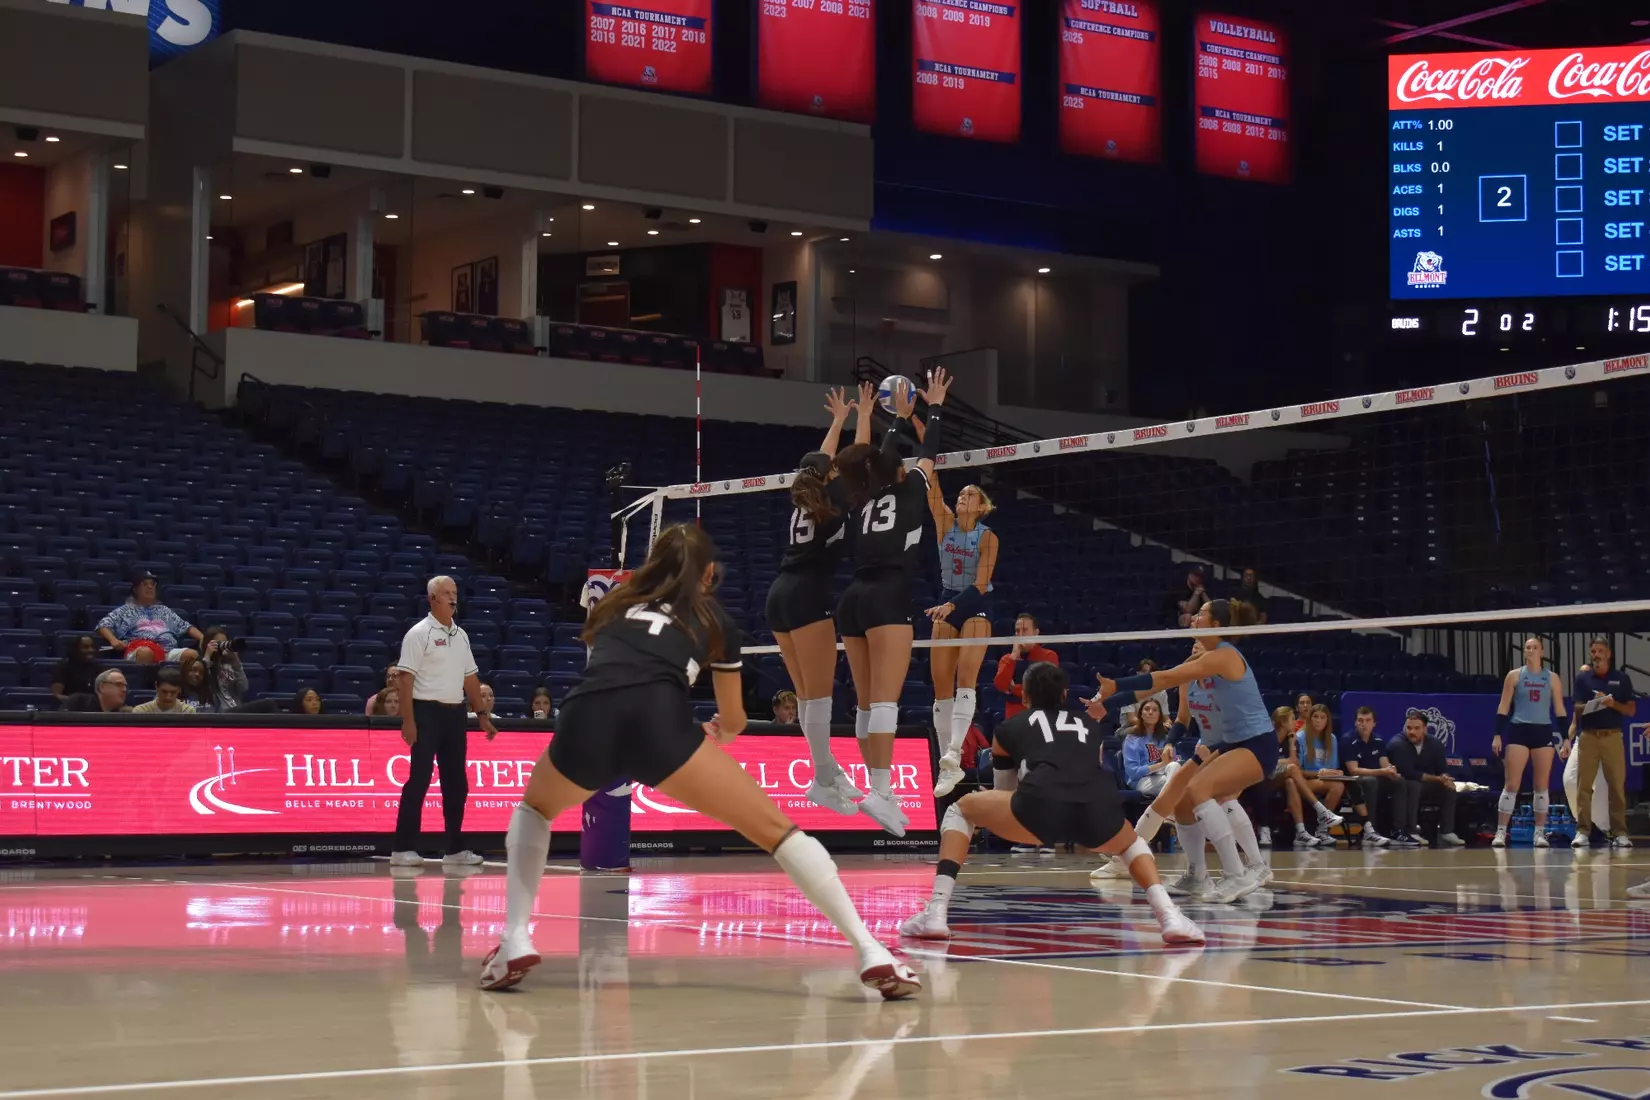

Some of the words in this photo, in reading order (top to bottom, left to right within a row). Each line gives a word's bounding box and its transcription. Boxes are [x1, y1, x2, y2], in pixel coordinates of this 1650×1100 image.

[611, 7, 632, 18] NCAA
[634, 10, 687, 26] TOURNAMENT
[763, 3, 786, 18] 2023
[820, 1, 843, 14] 2008
[848, 5, 869, 19] 2021
[916, 4, 938, 19] 2008
[942, 9, 965, 23] 2009
[969, 13, 990, 27] 2019
[969, 1, 1008, 15] CHAMPIONS
[1081, 0, 1138, 17] SOFTBALL
[591, 16, 615, 30] 2007
[621, 20, 647, 35] 2016
[652, 25, 676, 40] 2017
[682, 29, 706, 44] 2018
[1062, 31, 1084, 44] 2025
[1070, 20, 1112, 34] CONFERENCE
[1112, 27, 1149, 40] CHAMPIONS
[1209, 20, 1276, 43] VOLLEYBALL
[621, 34, 645, 48] 2021
[652, 38, 676, 52] 2022
[1206, 44, 1245, 58] CONFERENCE
[1245, 51, 1280, 64] CHAMPIONS
[934, 63, 951, 74] NCAA
[954, 66, 999, 81] TOURNAMENT
[1199, 66, 1218, 80] 2015
[1245, 62, 1264, 76] 2011
[916, 72, 938, 85] 2008
[942, 76, 964, 89] 2019
[1396, 57, 1531, 102] Coca-Cola
[1063, 96, 1084, 109] 2025
[1080, 87, 1096, 97] NCAA
[1098, 90, 1141, 104] TOURNAMENT
[1215, 109, 1231, 120] NCAA
[1232, 113, 1272, 126] TOURNAMENT
[1392, 120, 1423, 130] ATT%
[1428, 119, 1453, 131] 1.00
[1245, 125, 1264, 138] 2012
[1603, 124, 1644, 141] SET
[1393, 142, 1424, 151] KILLS
[1437, 141, 1443, 152] 1
[1393, 164, 1422, 173] BLKS
[1430, 162, 1450, 173] 0.0
[1603, 157, 1644, 174] SET
[1392, 185, 1423, 195] ACES
[1437, 183, 1444, 194] 1
[1497, 186, 1512, 208] 2
[1603, 189, 1645, 206] SET
[1393, 207, 1420, 217] DIGS
[1437, 204, 1444, 215] 1
[1393, 229, 1422, 238] ASTS
[1437, 225, 1444, 237] 1
[1604, 222, 1645, 239] SET
[1604, 254, 1645, 272] SET
[1408, 271, 1447, 284] BELMONT
[1462, 309, 1479, 336] 2
[1500, 314, 1512, 331] 0
[1522, 313, 1534, 331] 2
[1603, 354, 1649, 374] BELMONT
[1494, 372, 1538, 390] BRUINS
[1395, 387, 1434, 404] BELMONT
[1301, 401, 1339, 418] BRUINS
[1215, 414, 1249, 429] BELMONT
[1133, 426, 1167, 441] BRUINS
[1059, 436, 1088, 450] BELMONT
[986, 446, 1017, 459] BRUINS
[861, 494, 896, 535] 13
[790, 507, 815, 545] 15
[952, 558, 963, 576] 3
[1529, 689, 1541, 702] 15
[1028, 710, 1089, 743] 14
[0, 756, 91, 788] TER
[284, 753, 375, 787] HILL
[11, 800, 92, 810] BRENTWOOD
[285, 800, 321, 808] BELLE
[325, 800, 364, 808] MEADE
[475, 800, 521, 808] BRENTW
[0, 848, 37, 856] OARDS
[1278, 1044, 1598, 1082] RICK
